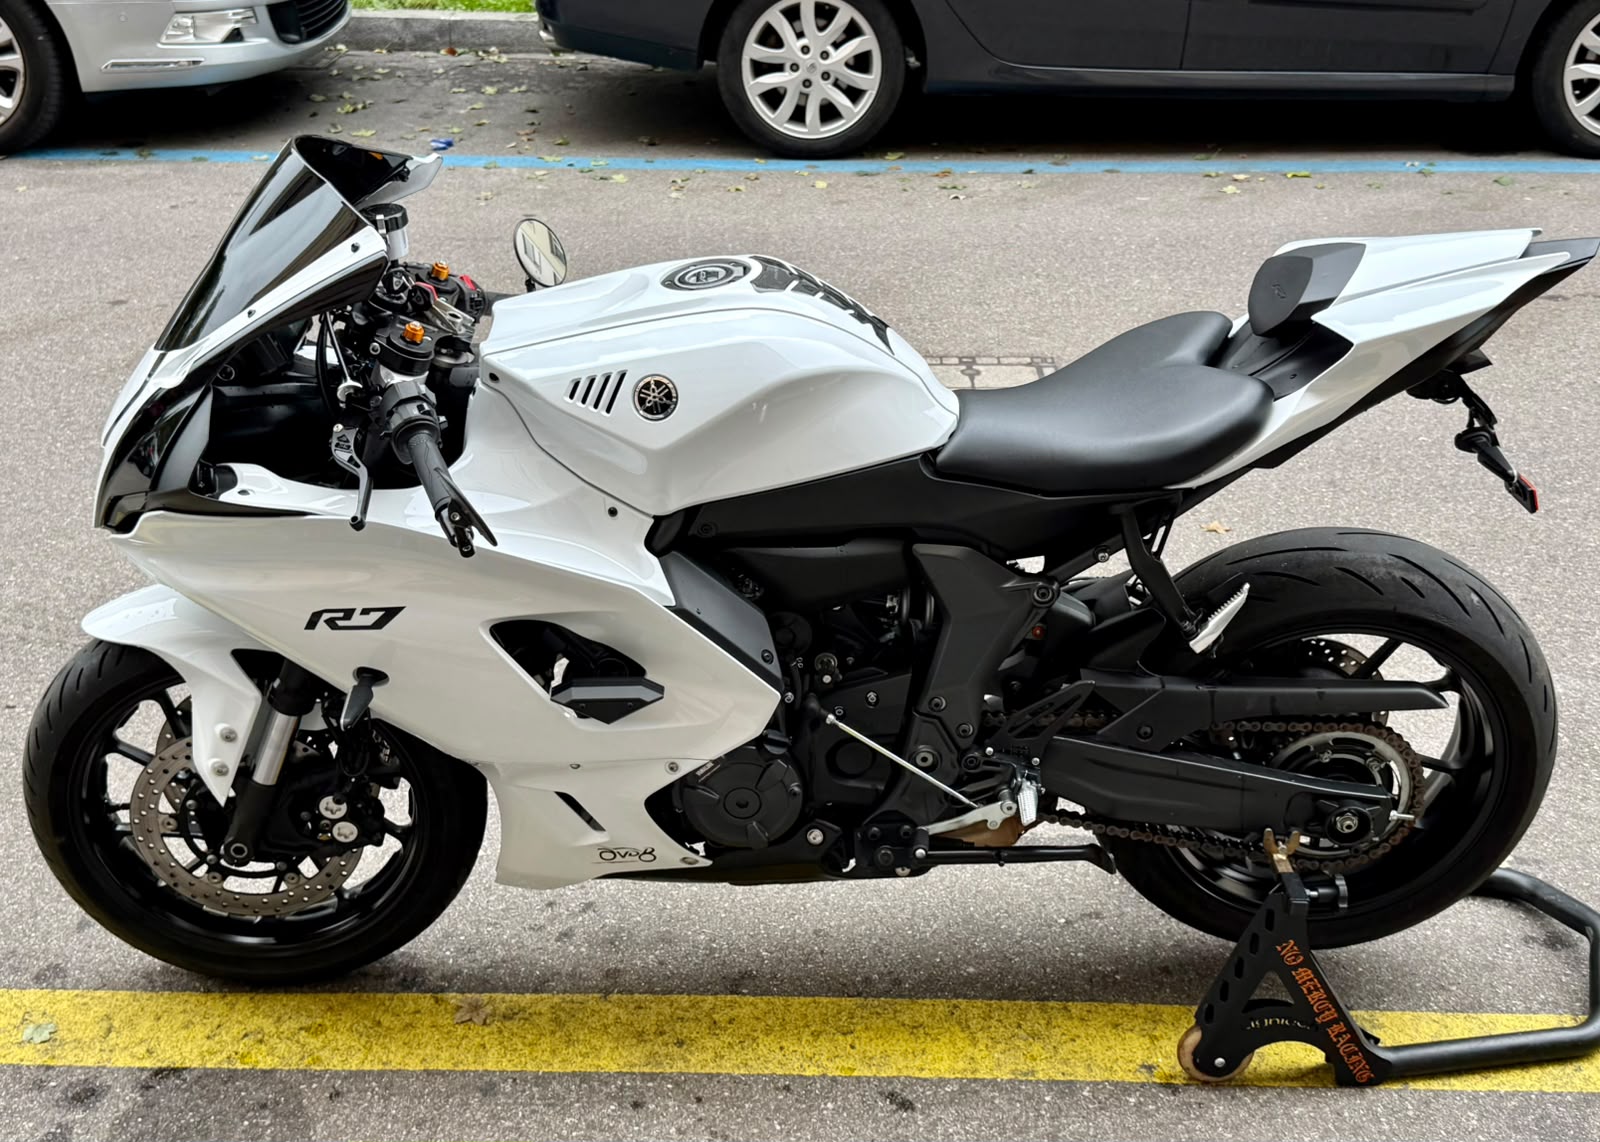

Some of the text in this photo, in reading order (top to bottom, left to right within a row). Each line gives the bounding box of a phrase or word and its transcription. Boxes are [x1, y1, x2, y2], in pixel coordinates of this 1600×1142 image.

[303, 605, 407, 631] R7
[1276, 939, 1305, 966] NO
[1292, 967, 1339, 1025] MERCY
[1327, 1022, 1375, 1084] RACING
